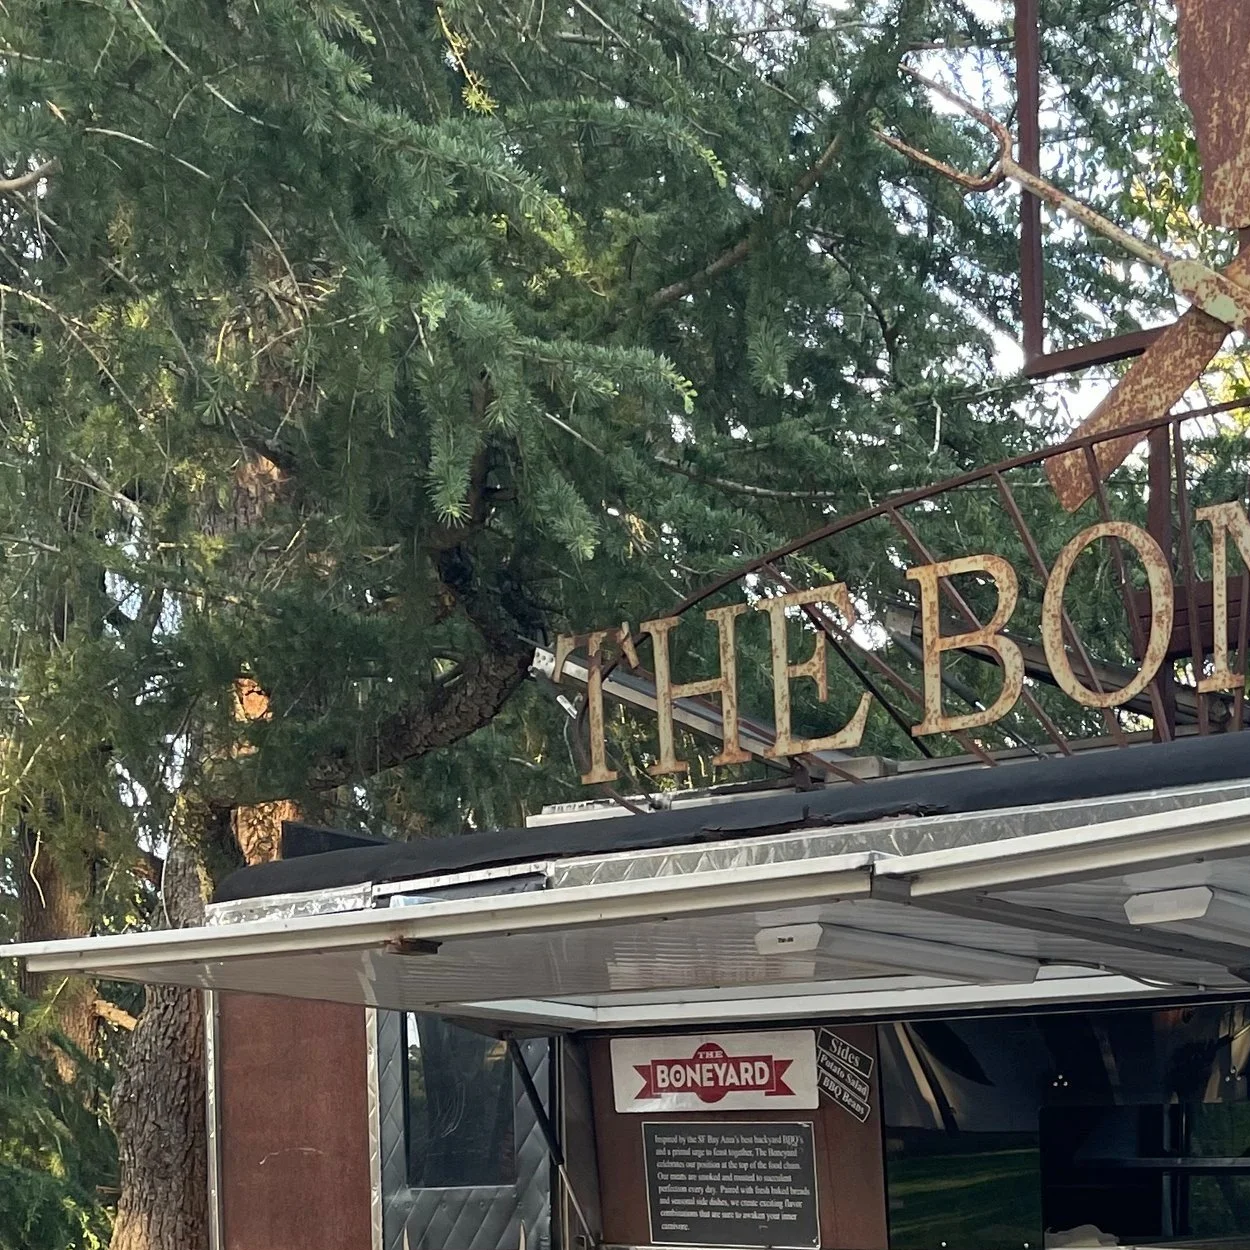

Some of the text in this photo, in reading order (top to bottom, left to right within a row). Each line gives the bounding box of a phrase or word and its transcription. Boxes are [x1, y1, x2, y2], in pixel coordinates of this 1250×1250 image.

[555, 582, 872, 786] THE
[697, 1051, 723, 1059] THE
[829, 1038, 860, 1067] Sides
[656, 1061, 769, 1088] BONEYARD
[820, 1054, 869, 1096] Potato Salad
[823, 1076, 864, 1115] BBQ Beans
